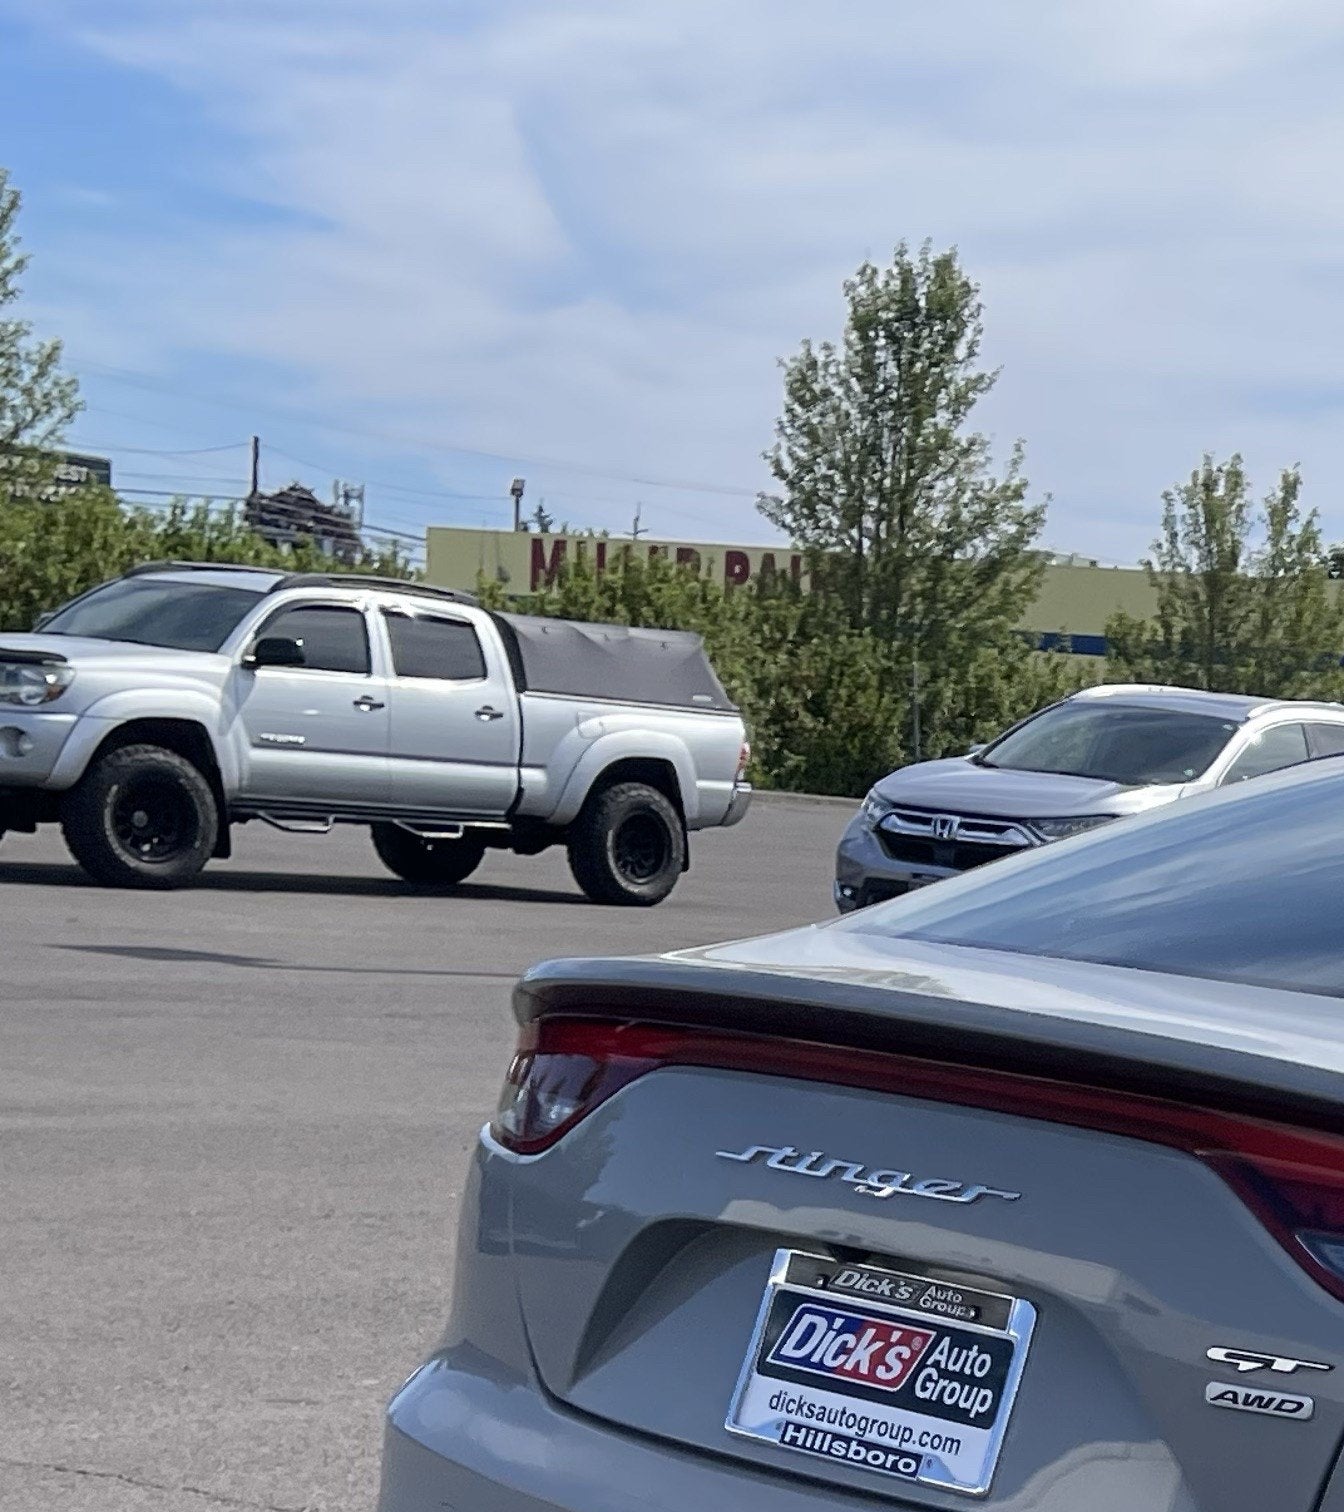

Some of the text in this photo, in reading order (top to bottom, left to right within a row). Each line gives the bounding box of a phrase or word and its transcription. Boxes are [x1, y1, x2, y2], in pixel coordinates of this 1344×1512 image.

[834, 1269, 913, 1301] Dick's
[923, 1285, 963, 1303] Auto
[919, 1295, 969, 1317] Group
[926, 1336, 992, 1378] Auto
[914, 1367, 994, 1419] Group
[1209, 1389, 1305, 1414] AWD
[769, 1389, 962, 1456] dicksautogroup.com
[783, 1422, 917, 1474] Hillsboro
